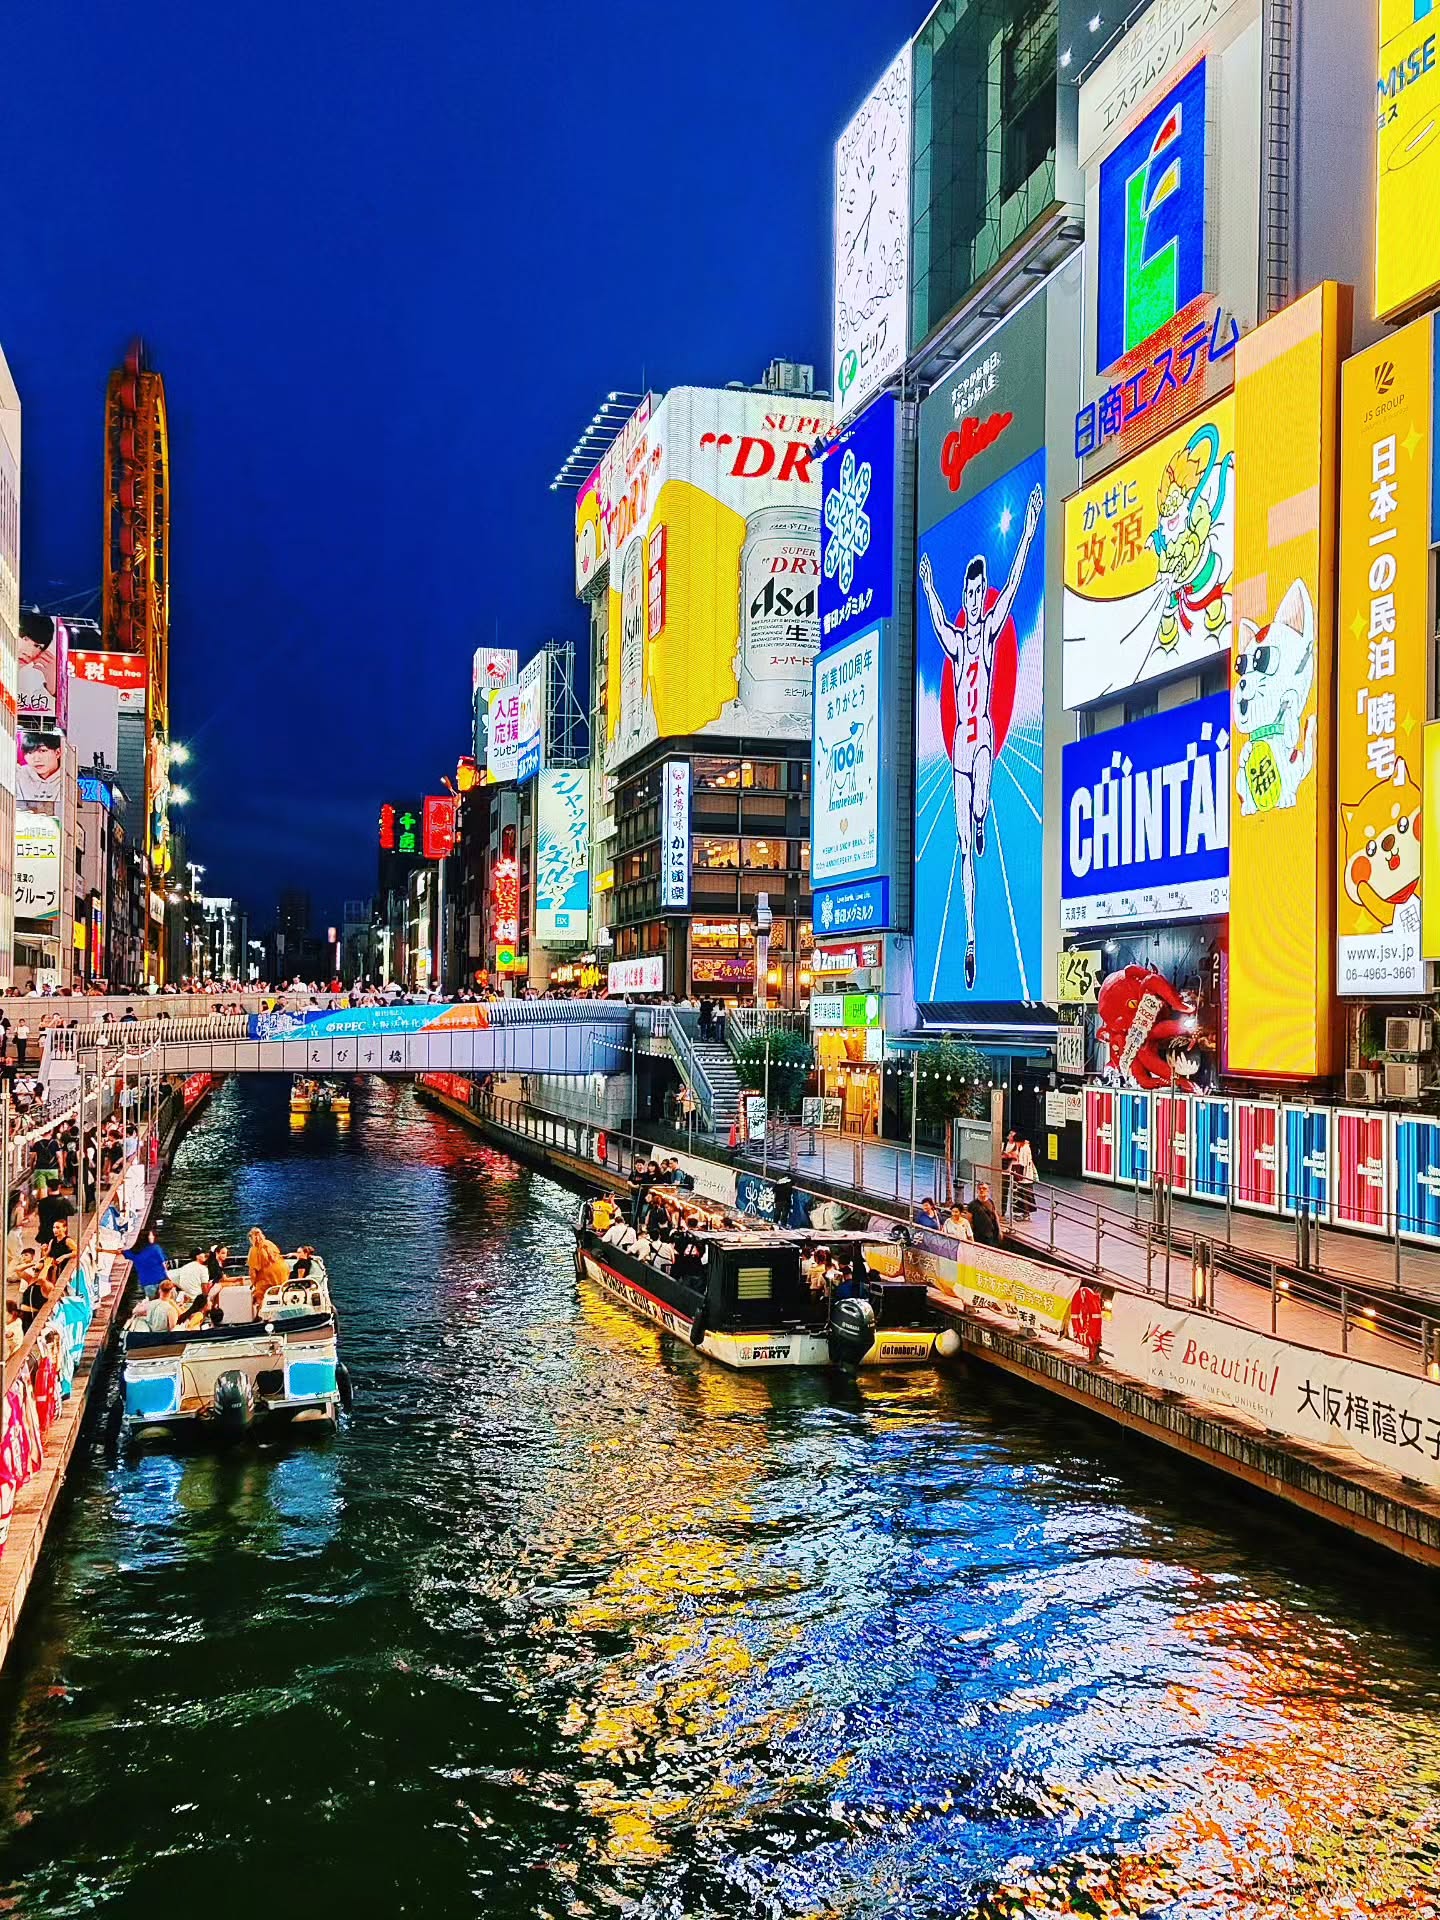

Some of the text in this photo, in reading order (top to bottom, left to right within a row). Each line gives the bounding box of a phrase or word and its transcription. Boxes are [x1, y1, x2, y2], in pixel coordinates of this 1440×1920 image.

[860, 312, 889, 368] ピップ
[1075, 307, 1239, 459] 日商エステム
[1364, 409, 1374, 423] JS
[1375, 394, 1405, 417] GROUP
[1083, 479, 1139, 531] かぜに
[782, 546, 816, 557] SUPER
[1076, 505, 1146, 587] 改源
[786, 625, 810, 642] 生
[770, 656, 814, 667] スーパード
[820, 650, 873, 695] 創業100周年
[494, 696, 518, 721] 入店
[826, 683, 866, 721] ありがとう
[966, 655, 979, 744] グリコ
[494, 719, 518, 744] 応援
[1069, 722, 1230, 877] CHINTAI
[15, 886, 56, 906] グループ
[1347, 944, 1414, 962] www.jsv.jp
[1346, 966, 1416, 981] 06-4963-3661
[1138, 1006, 1155, 1022] 2025
[311, 1050, 402, 1063] えびす橋
[752, 1349, 790, 1360] PARTY
[1182, 1338, 1280, 1397] Beautiful
[1297, 1378, 1440, 1461] 大阪樟蔭女子
